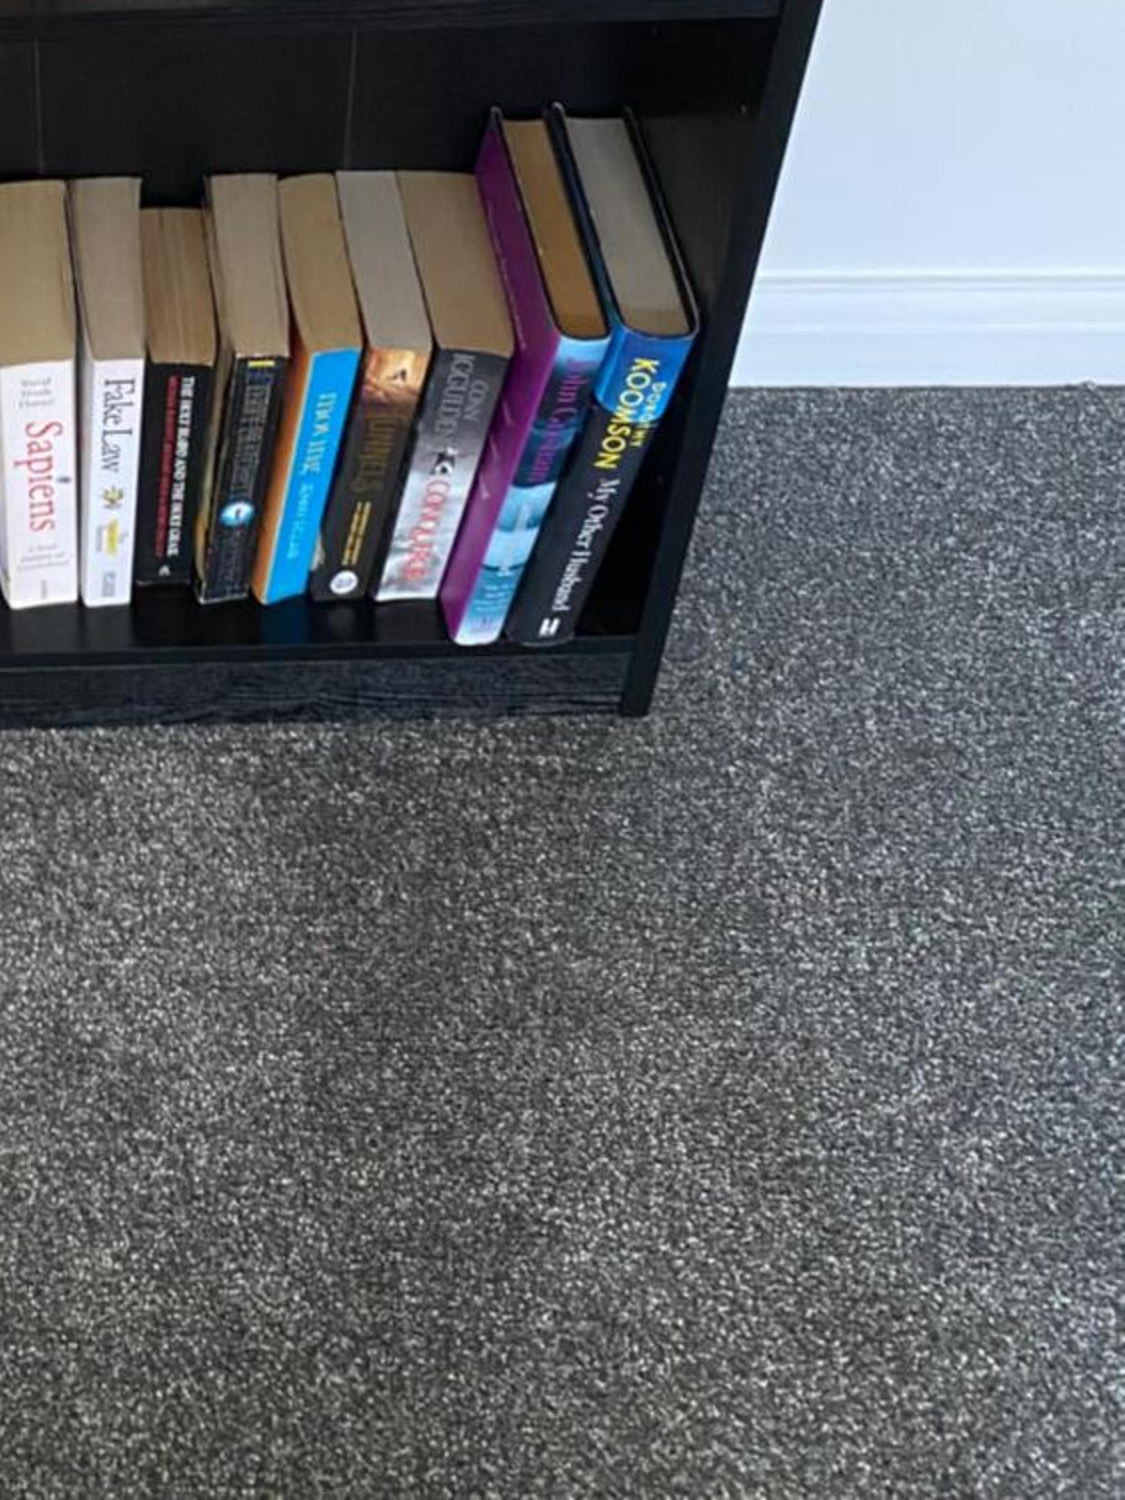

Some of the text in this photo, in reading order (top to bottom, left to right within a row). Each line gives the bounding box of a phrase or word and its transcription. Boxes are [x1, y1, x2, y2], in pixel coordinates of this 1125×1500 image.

[99, 378, 137, 473] Fake Law
[179, 376, 196, 398] THE
[591, 356, 662, 471] KOOMSON
[14, 419, 65, 533] Sapiens
[551, 476, 621, 614] My Other Husband
